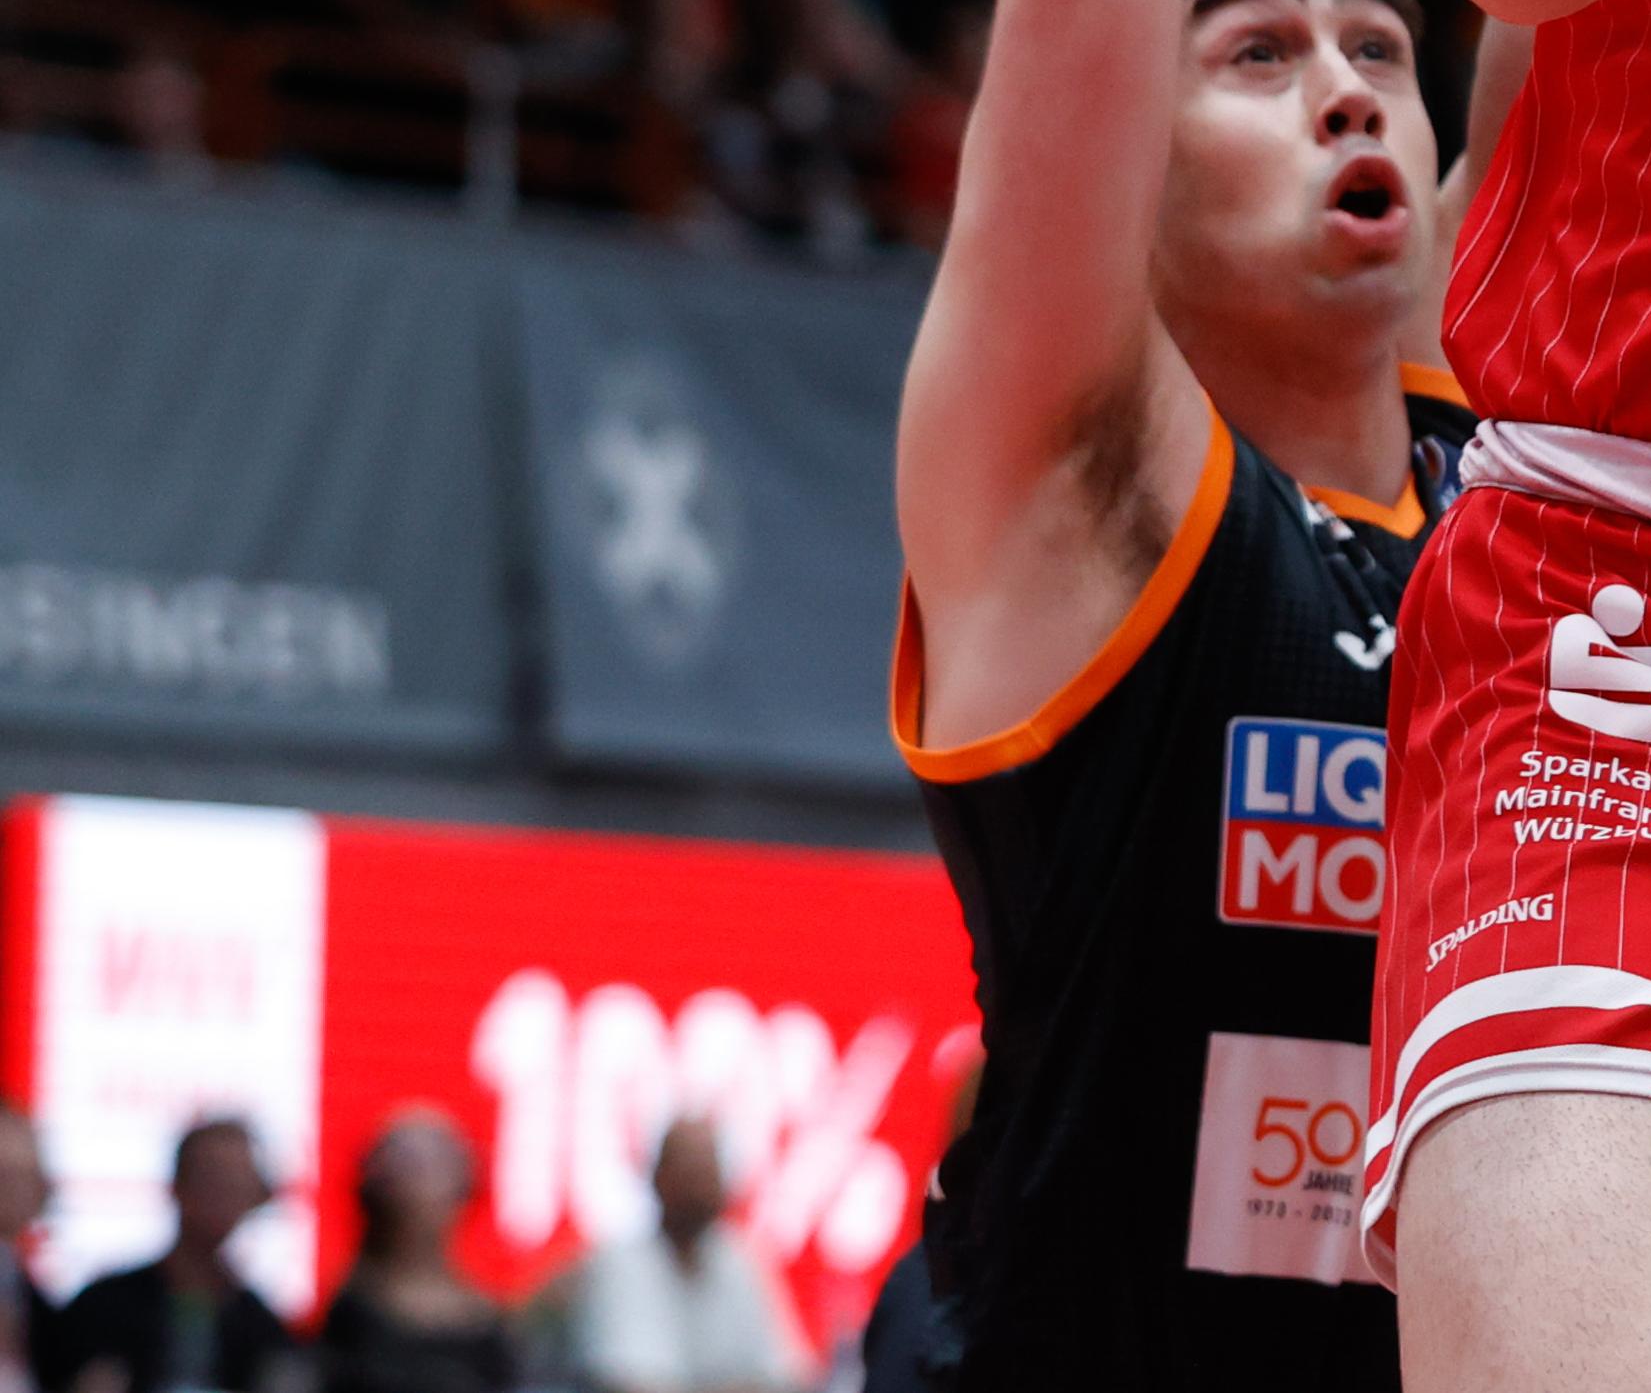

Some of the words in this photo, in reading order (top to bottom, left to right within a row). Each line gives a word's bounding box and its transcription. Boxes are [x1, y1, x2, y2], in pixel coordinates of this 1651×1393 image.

[1244, 731, 1387, 828] LIQ
[1239, 828, 1386, 922] MO
[1425, 893, 1554, 972] SPALDING
[1251, 1095, 1362, 1188] 50
